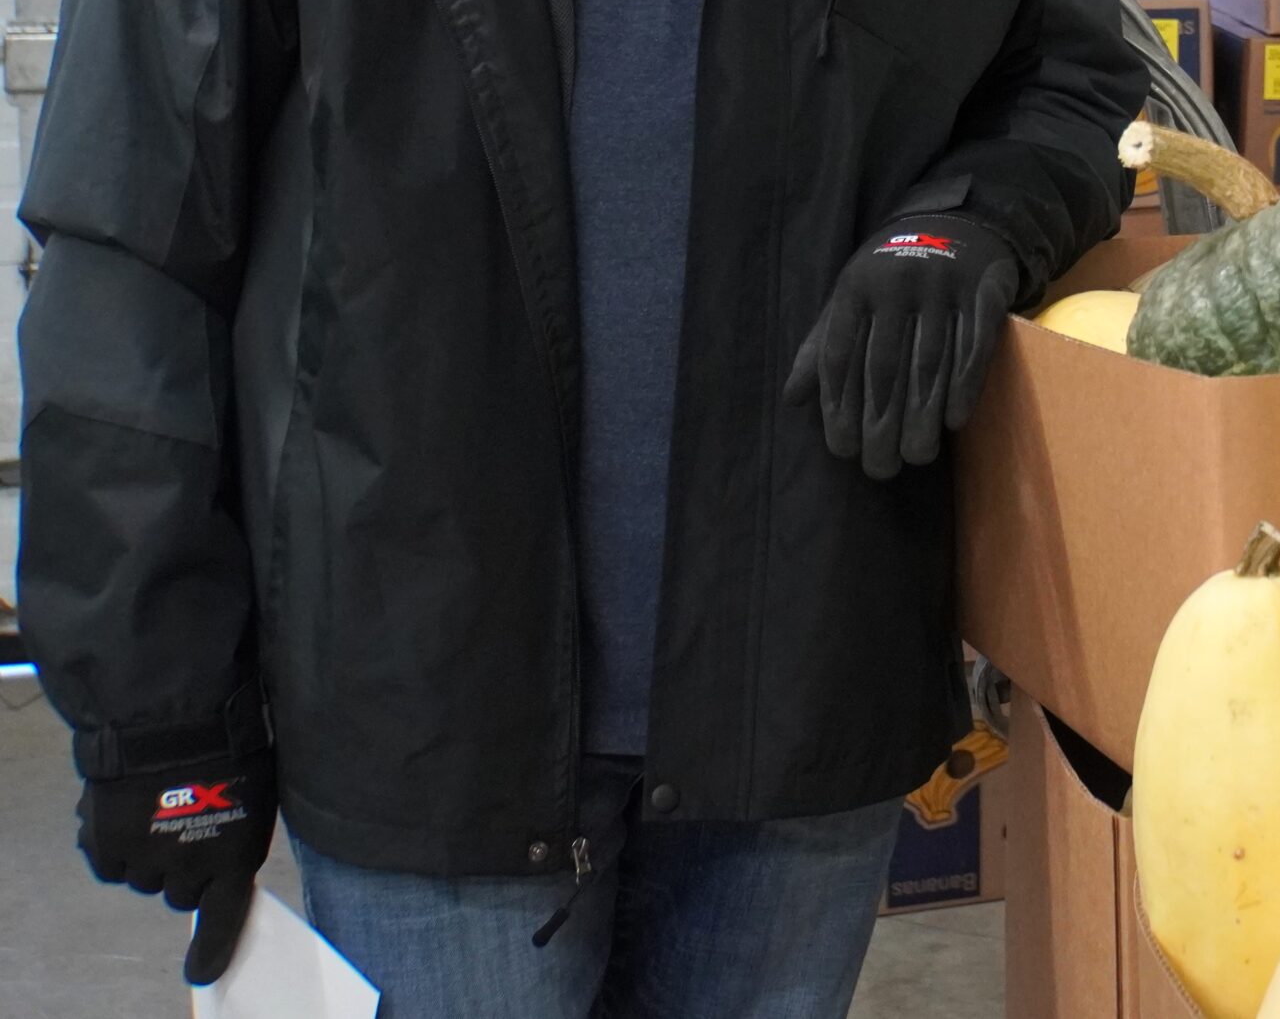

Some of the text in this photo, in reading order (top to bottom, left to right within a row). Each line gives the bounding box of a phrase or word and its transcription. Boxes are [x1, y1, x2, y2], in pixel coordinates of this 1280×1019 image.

[889, 233, 953, 250] GRX
[159, 783, 233, 809] GRX
[890, 873, 978, 897] Bananas
